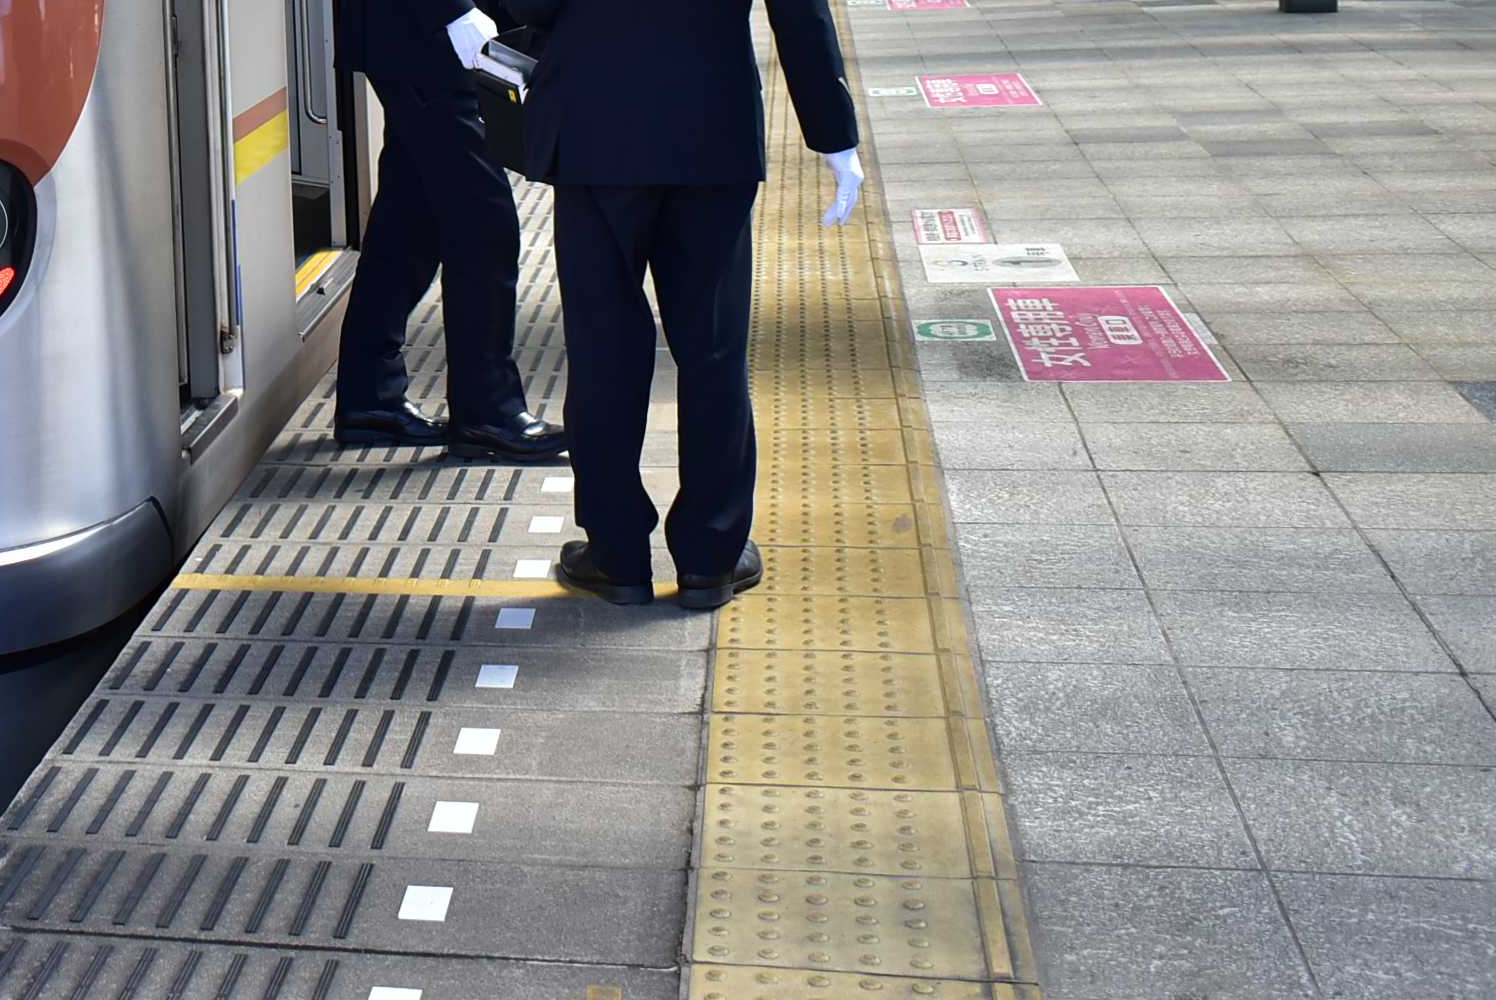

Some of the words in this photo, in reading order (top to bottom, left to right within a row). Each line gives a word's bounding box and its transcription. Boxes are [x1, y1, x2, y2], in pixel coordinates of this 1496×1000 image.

[1005, 298, 1091, 367] 女性専用車
